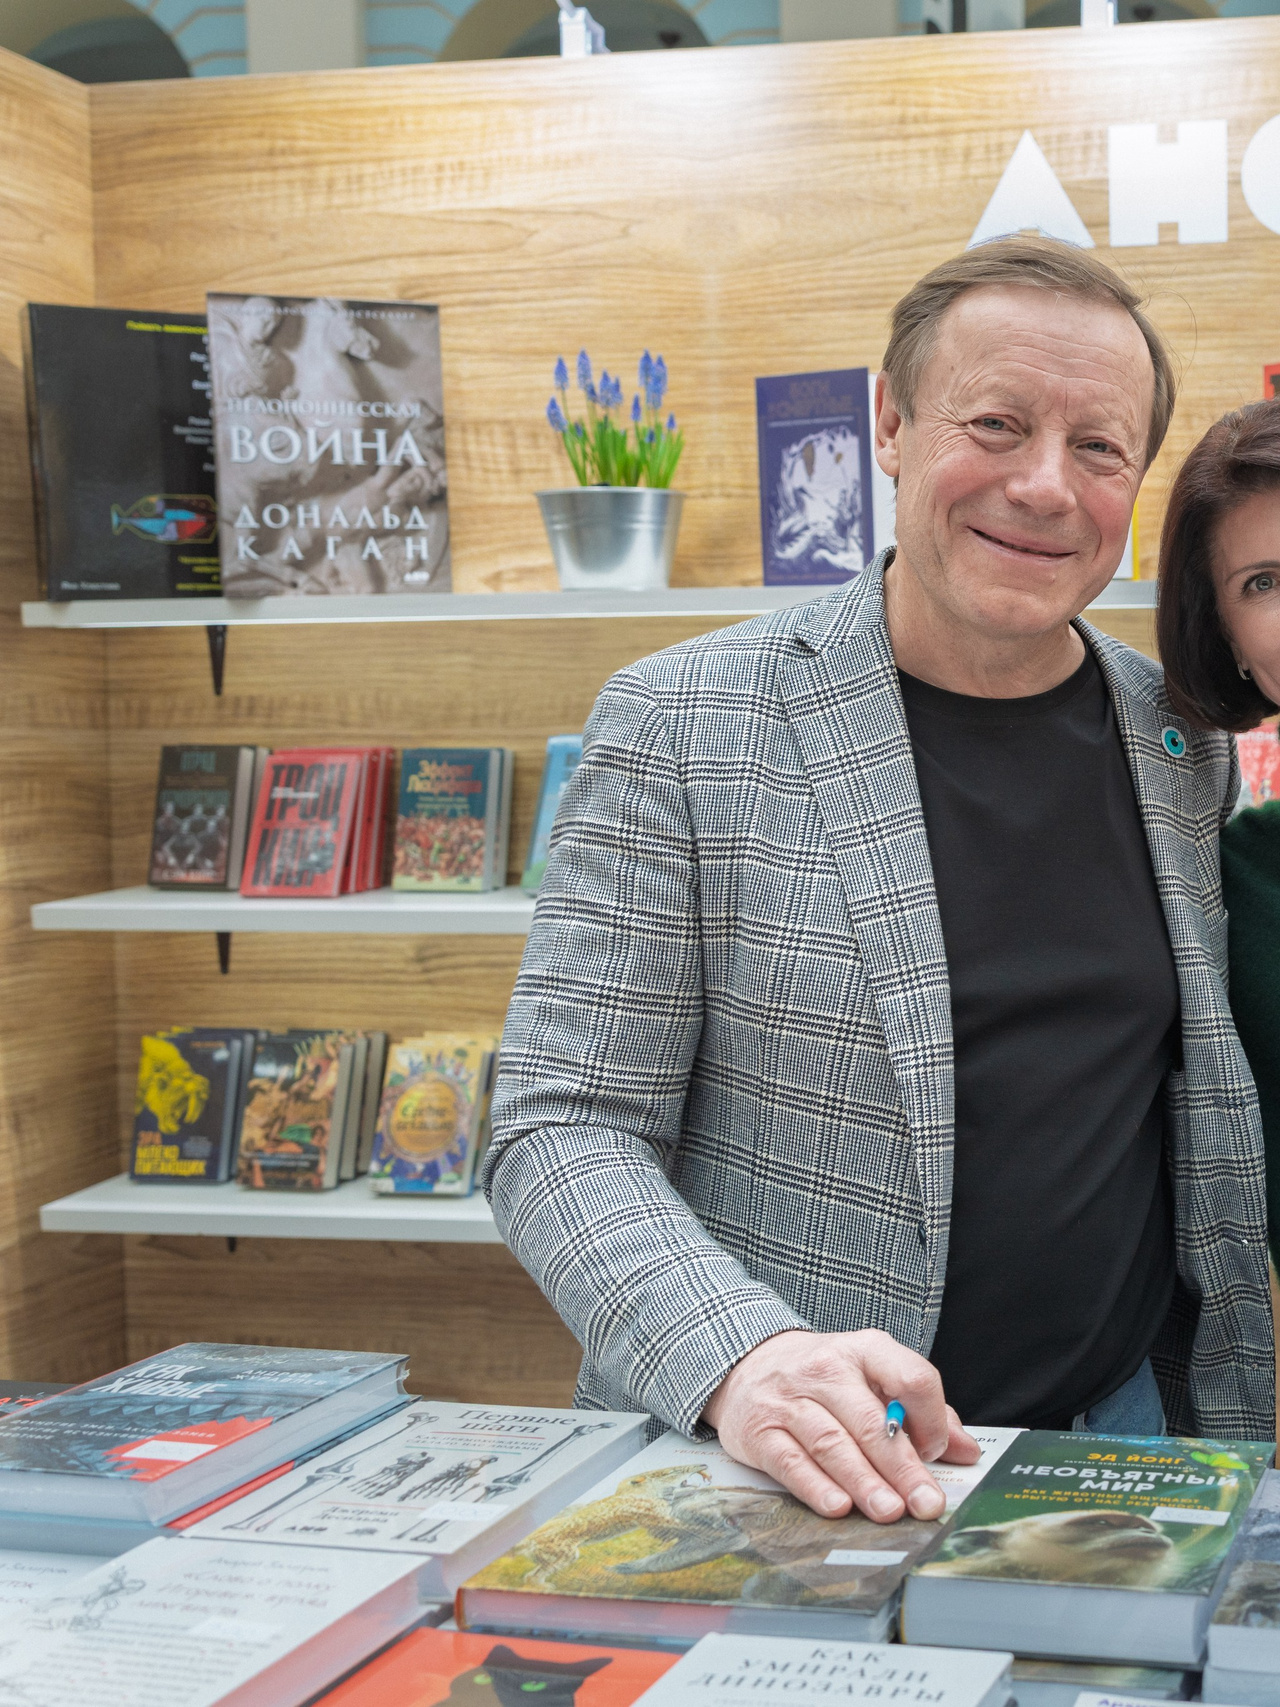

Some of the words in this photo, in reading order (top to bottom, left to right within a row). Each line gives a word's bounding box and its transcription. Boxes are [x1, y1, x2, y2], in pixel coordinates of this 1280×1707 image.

[229, 421, 428, 467] ВОЙНА
[235, 503, 429, 530] ДОНАЛЬД
[237, 536, 429, 561] КАГАН
[126, 1363, 207, 1382] КАК
[87, 1377, 228, 1399] ЖИВЫЕ
[455, 1410, 577, 1425] Первые
[460, 1422, 543, 1433] шаги
[673, 1448, 730, 1457] УВЛЕКАТЕ
[1087, 1452, 1117, 1462] ЭД
[1126, 1453, 1186, 1465] ЙОНГ
[1010, 1464, 1240, 1487] НЕОБЪЯТНЫЙ
[1079, 1480, 1156, 1493] МИР
[1004, 1493, 1069, 1502] СКРЫТУЮ
[1126, 1500, 1211, 1510] РЕАЛЬНОСТЬ
[1052, 1490, 1125, 1499] ЖИВОТНЫЕ
[1129, 1494, 1200, 1504] ОЩУЩАЮТ
[811, 1647, 887, 1663] КАК
[738, 1658, 930, 1683] УМИРАЛИ
[686, 1673, 949, 1702] ДИНОЗАВРЫ
